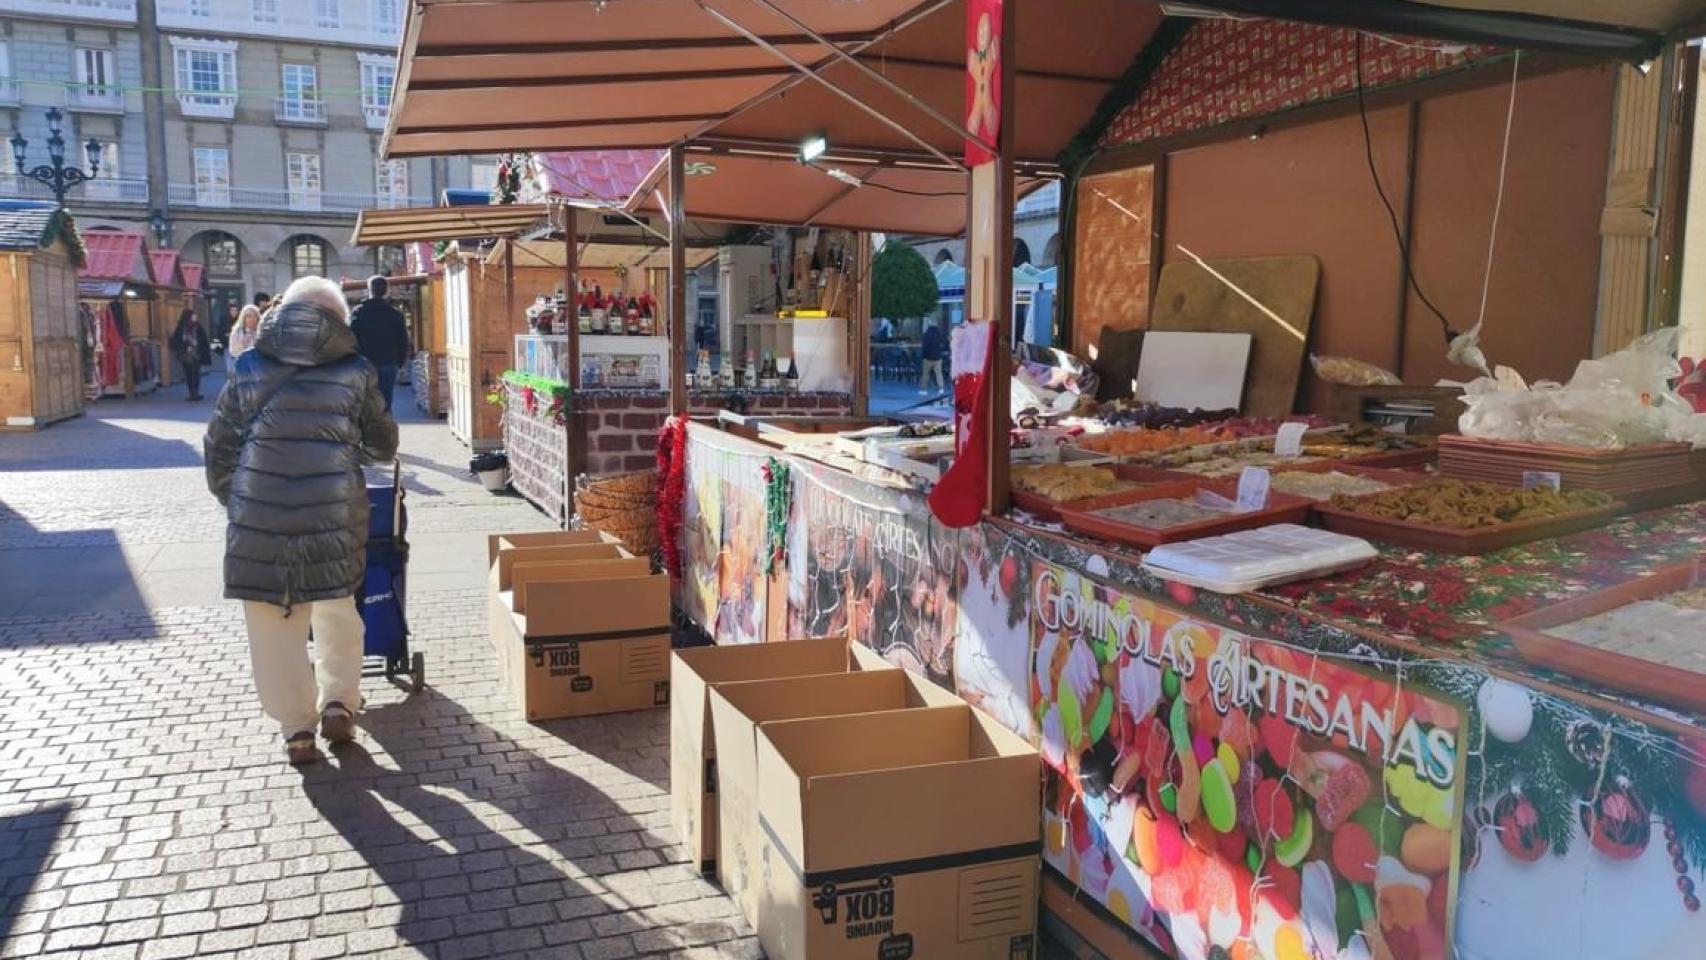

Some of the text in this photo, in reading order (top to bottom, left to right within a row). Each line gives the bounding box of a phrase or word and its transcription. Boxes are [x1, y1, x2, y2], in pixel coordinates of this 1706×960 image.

[549, 650, 580, 667] BOX
[1036, 570, 1455, 787] GOMINOLAS ARTESANAS
[845, 890, 894, 923] BOX
[846, 920, 894, 939] MOVING
